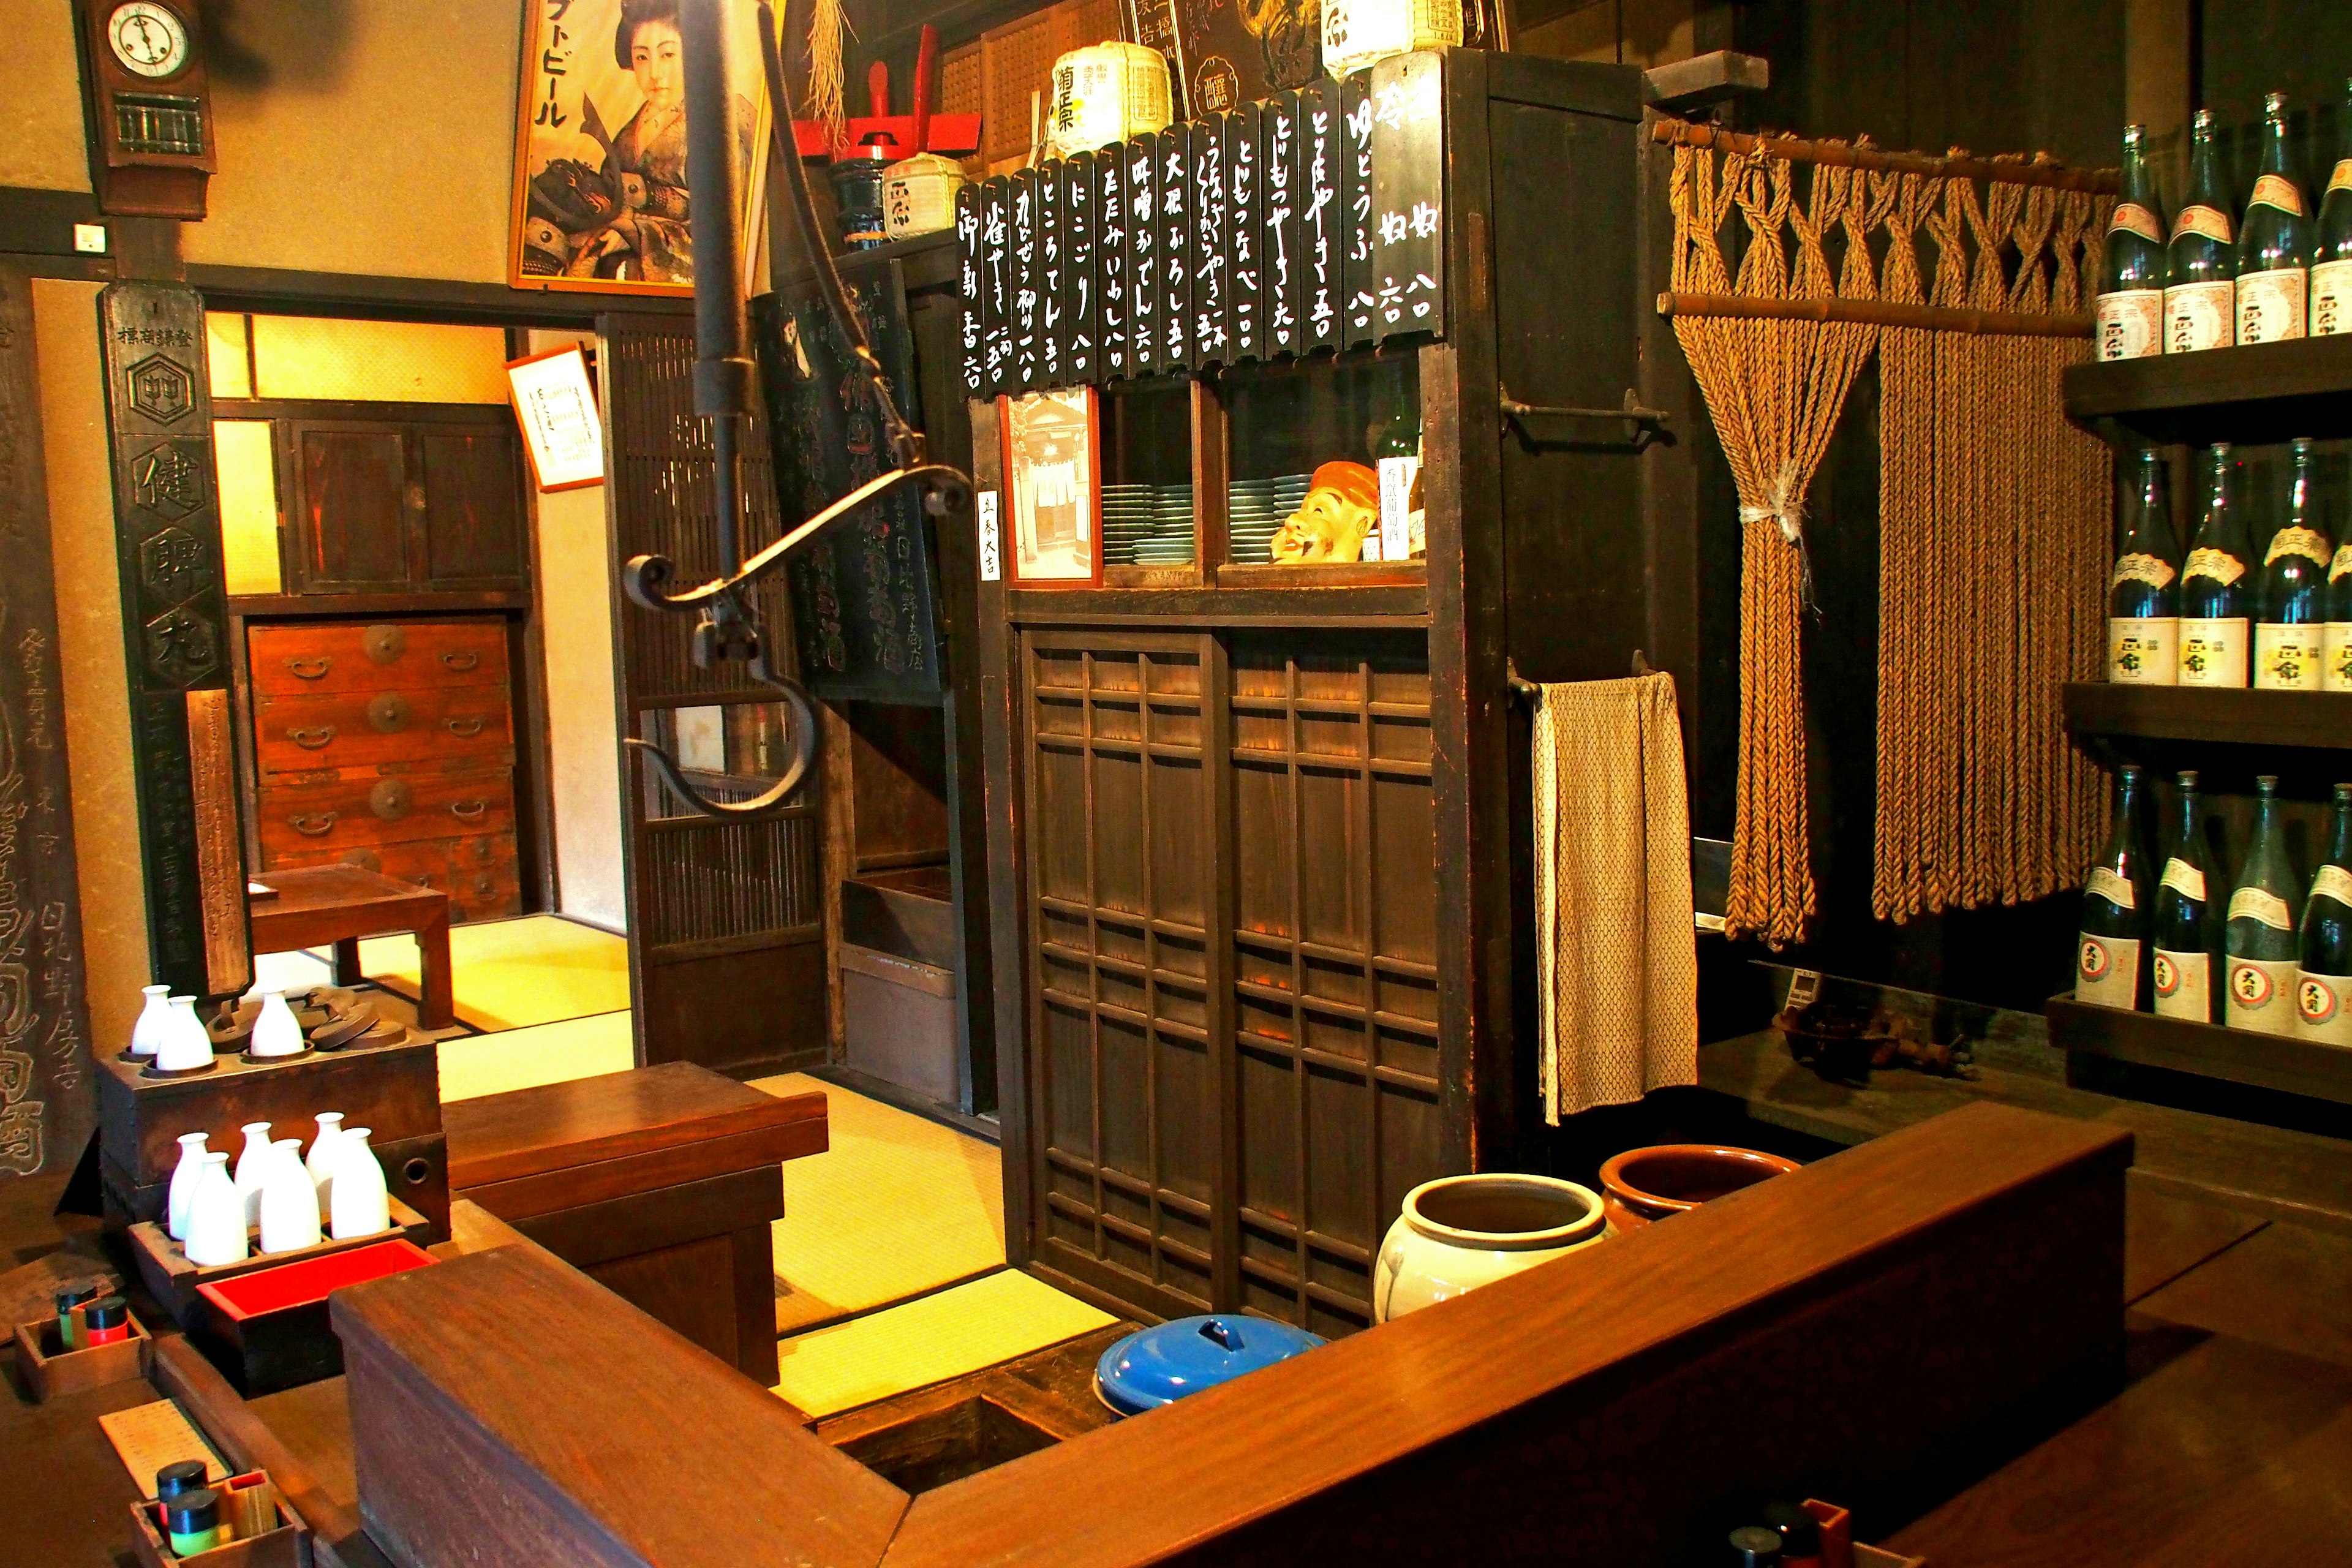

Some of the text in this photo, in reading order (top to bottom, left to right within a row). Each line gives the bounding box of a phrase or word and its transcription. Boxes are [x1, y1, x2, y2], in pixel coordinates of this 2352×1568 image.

[1055, 66, 1074, 132] 菊正宗
[983, 497, 996, 573] 立春大吉
